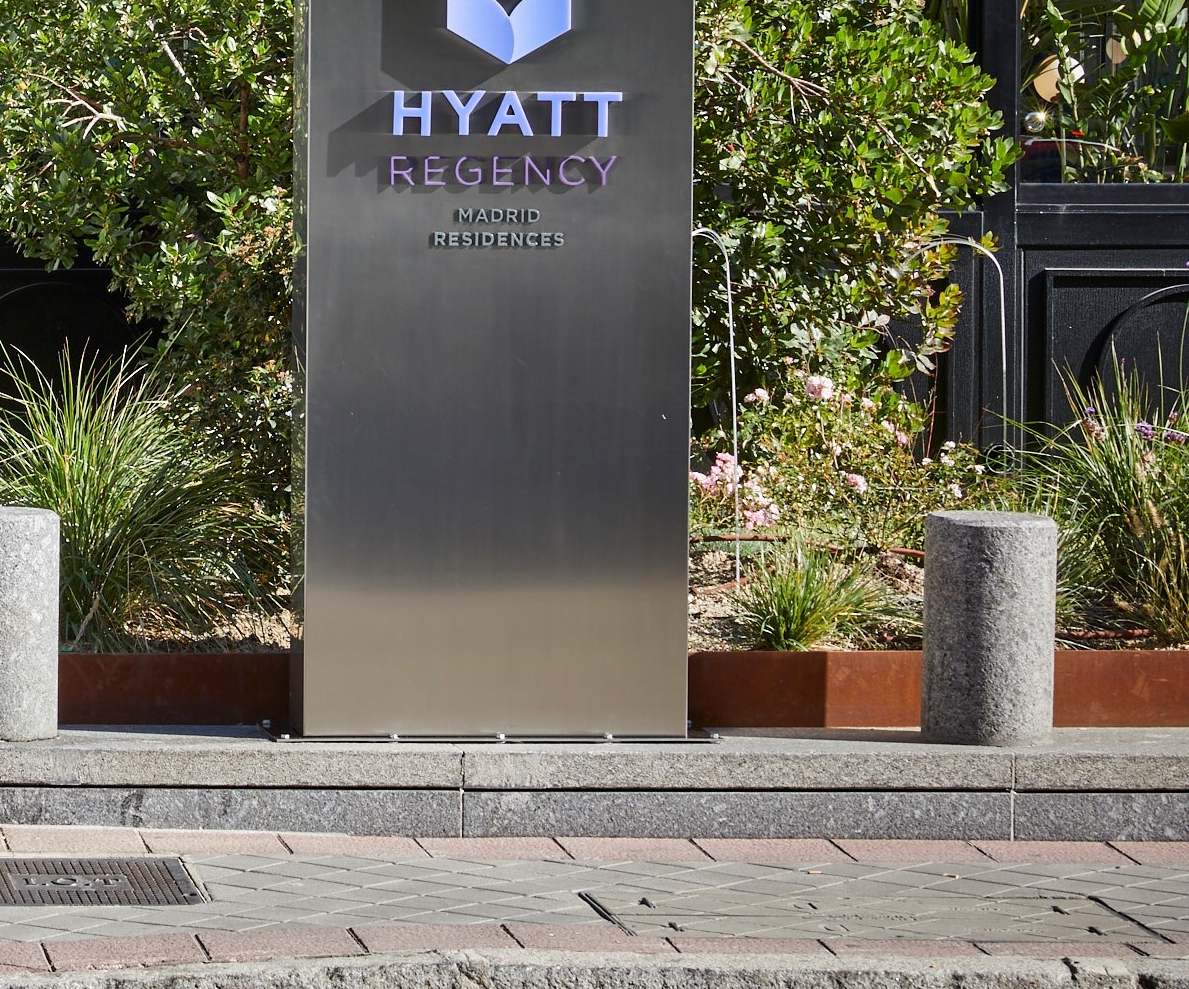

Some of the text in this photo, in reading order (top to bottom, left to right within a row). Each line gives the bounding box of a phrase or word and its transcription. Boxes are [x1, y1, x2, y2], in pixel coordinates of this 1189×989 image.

[391, 90, 624, 138] HYATT
[389, 155, 618, 187] REGENCY
[457, 208, 541, 223] MADRID
[433, 231, 565, 247] RESIDENCES
